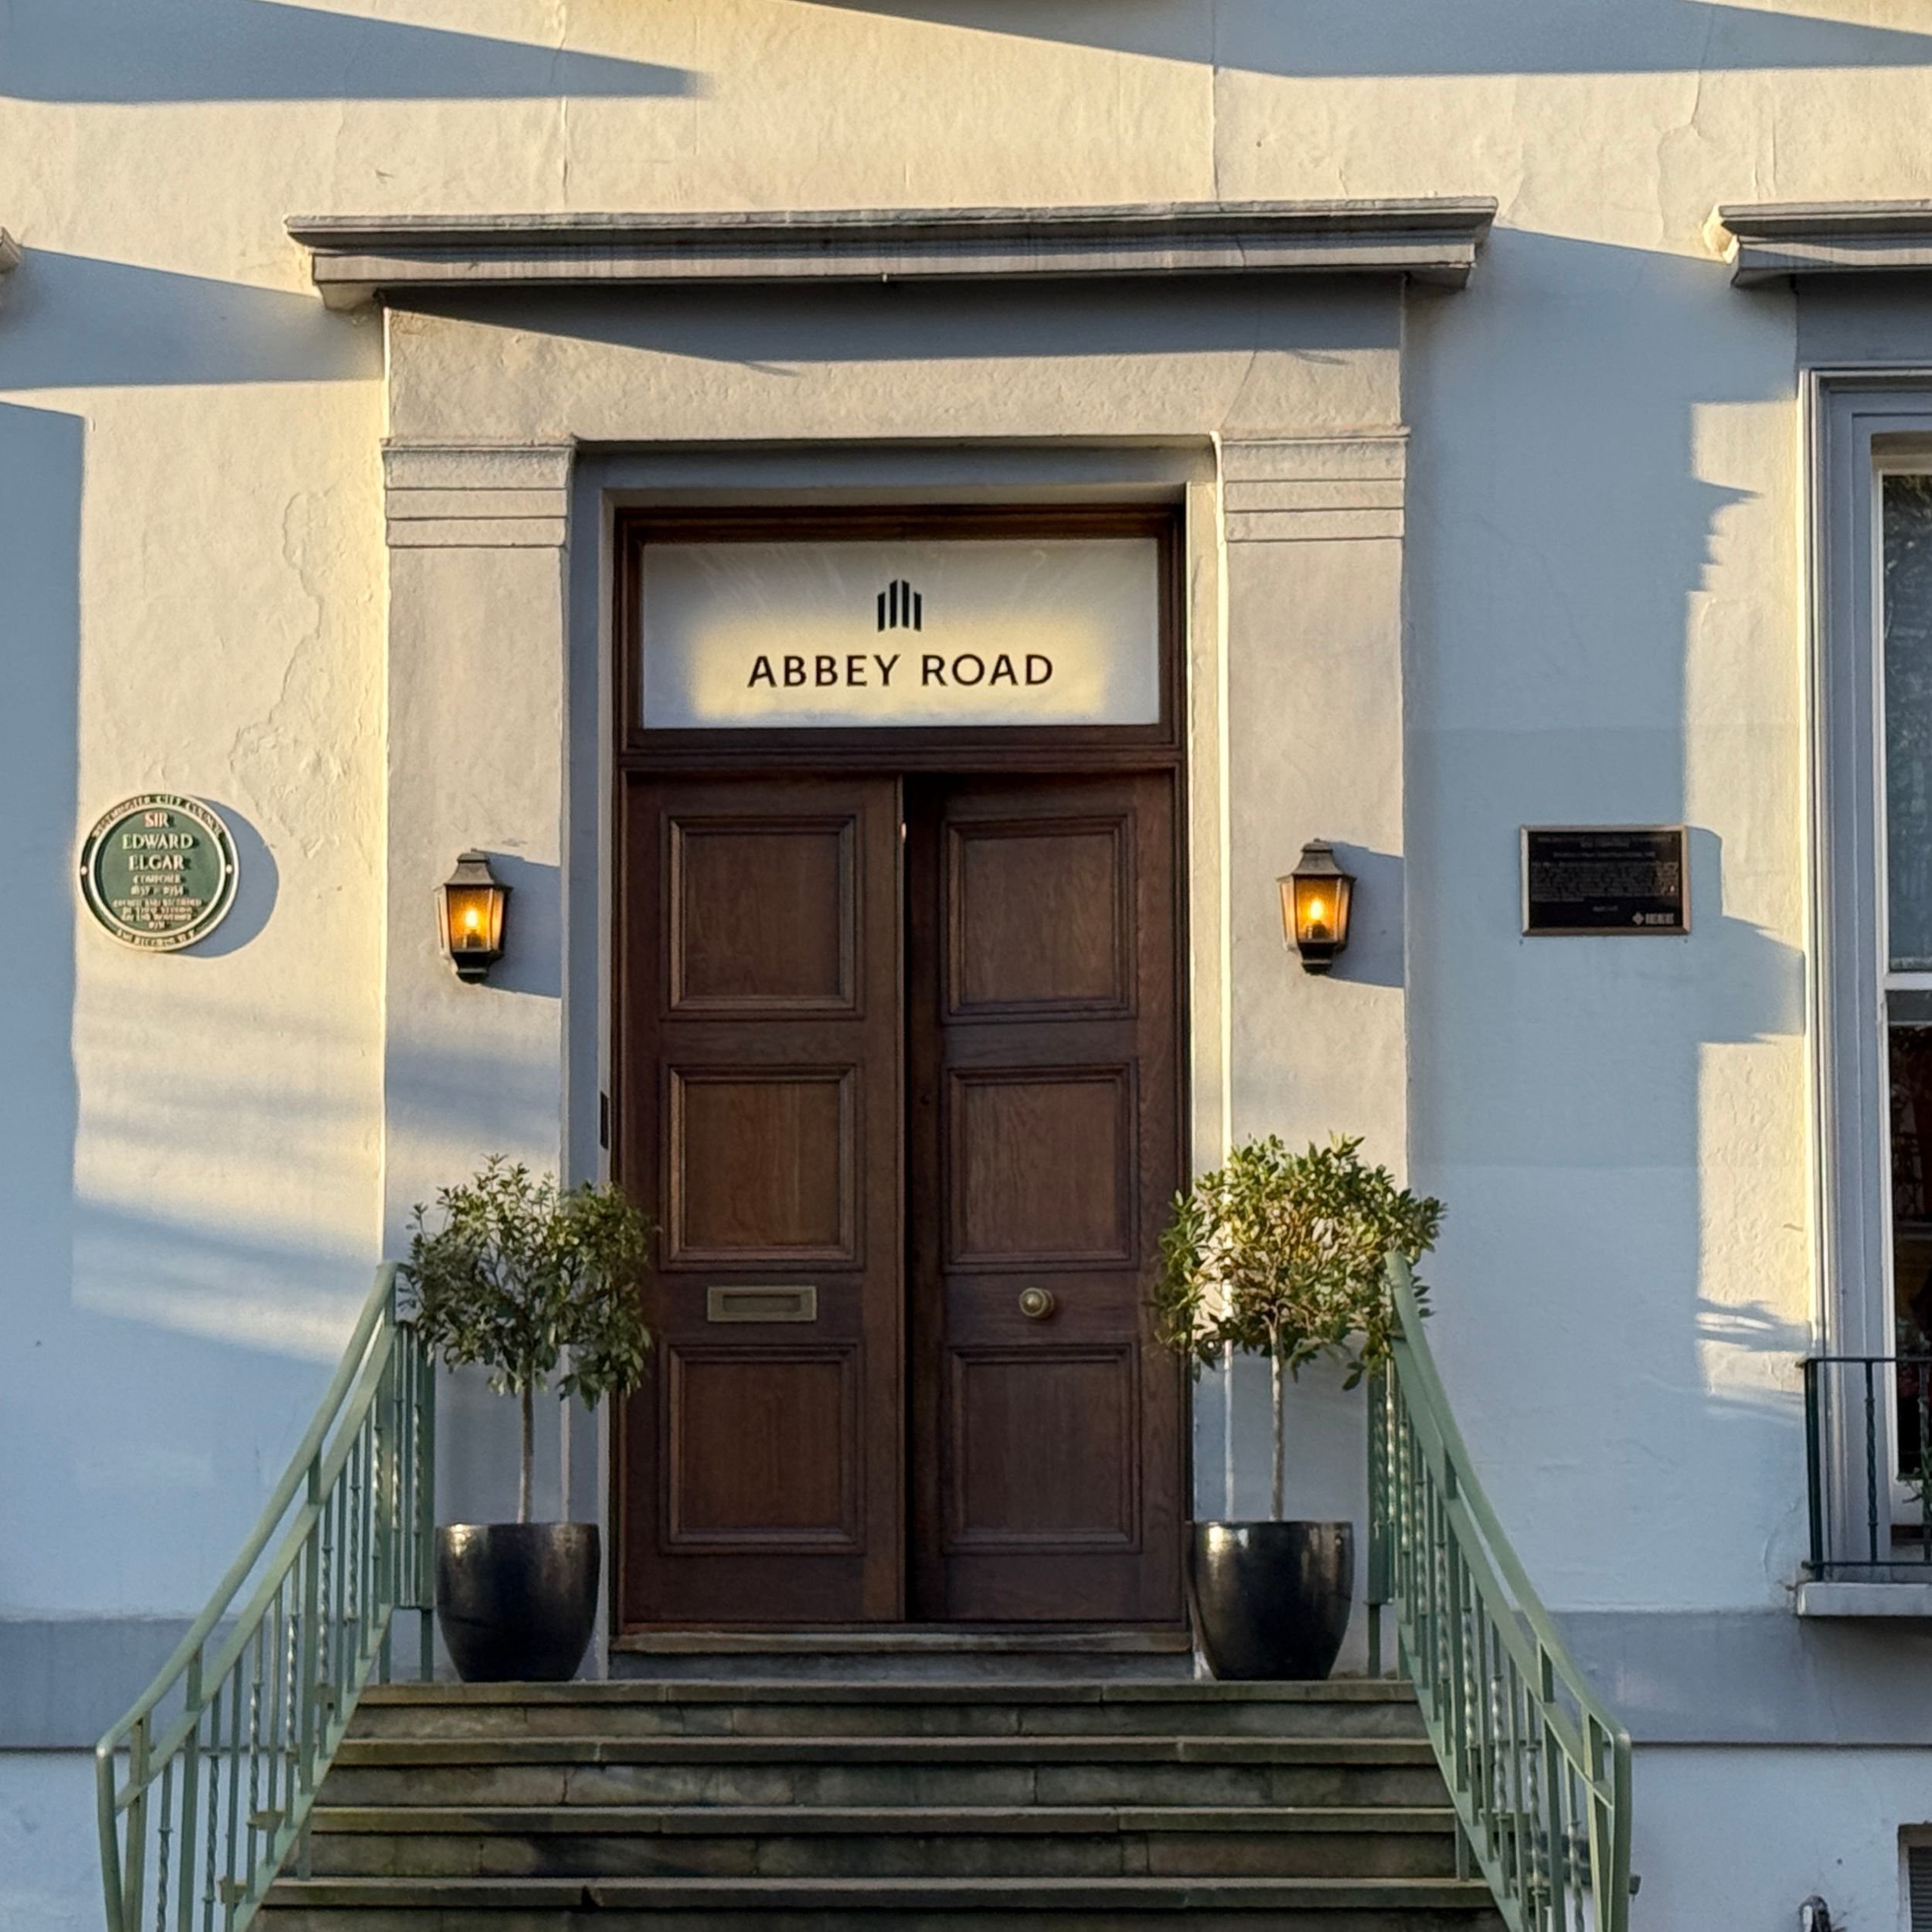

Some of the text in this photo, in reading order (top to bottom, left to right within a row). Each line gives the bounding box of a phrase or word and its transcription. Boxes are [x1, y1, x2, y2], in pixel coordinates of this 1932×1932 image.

[747, 654, 1053, 688] ABBEY ROAD
[144, 812, 169, 828] SIR
[122, 834, 194, 849] EDWARD
[128, 855, 184, 871] ELGAR
